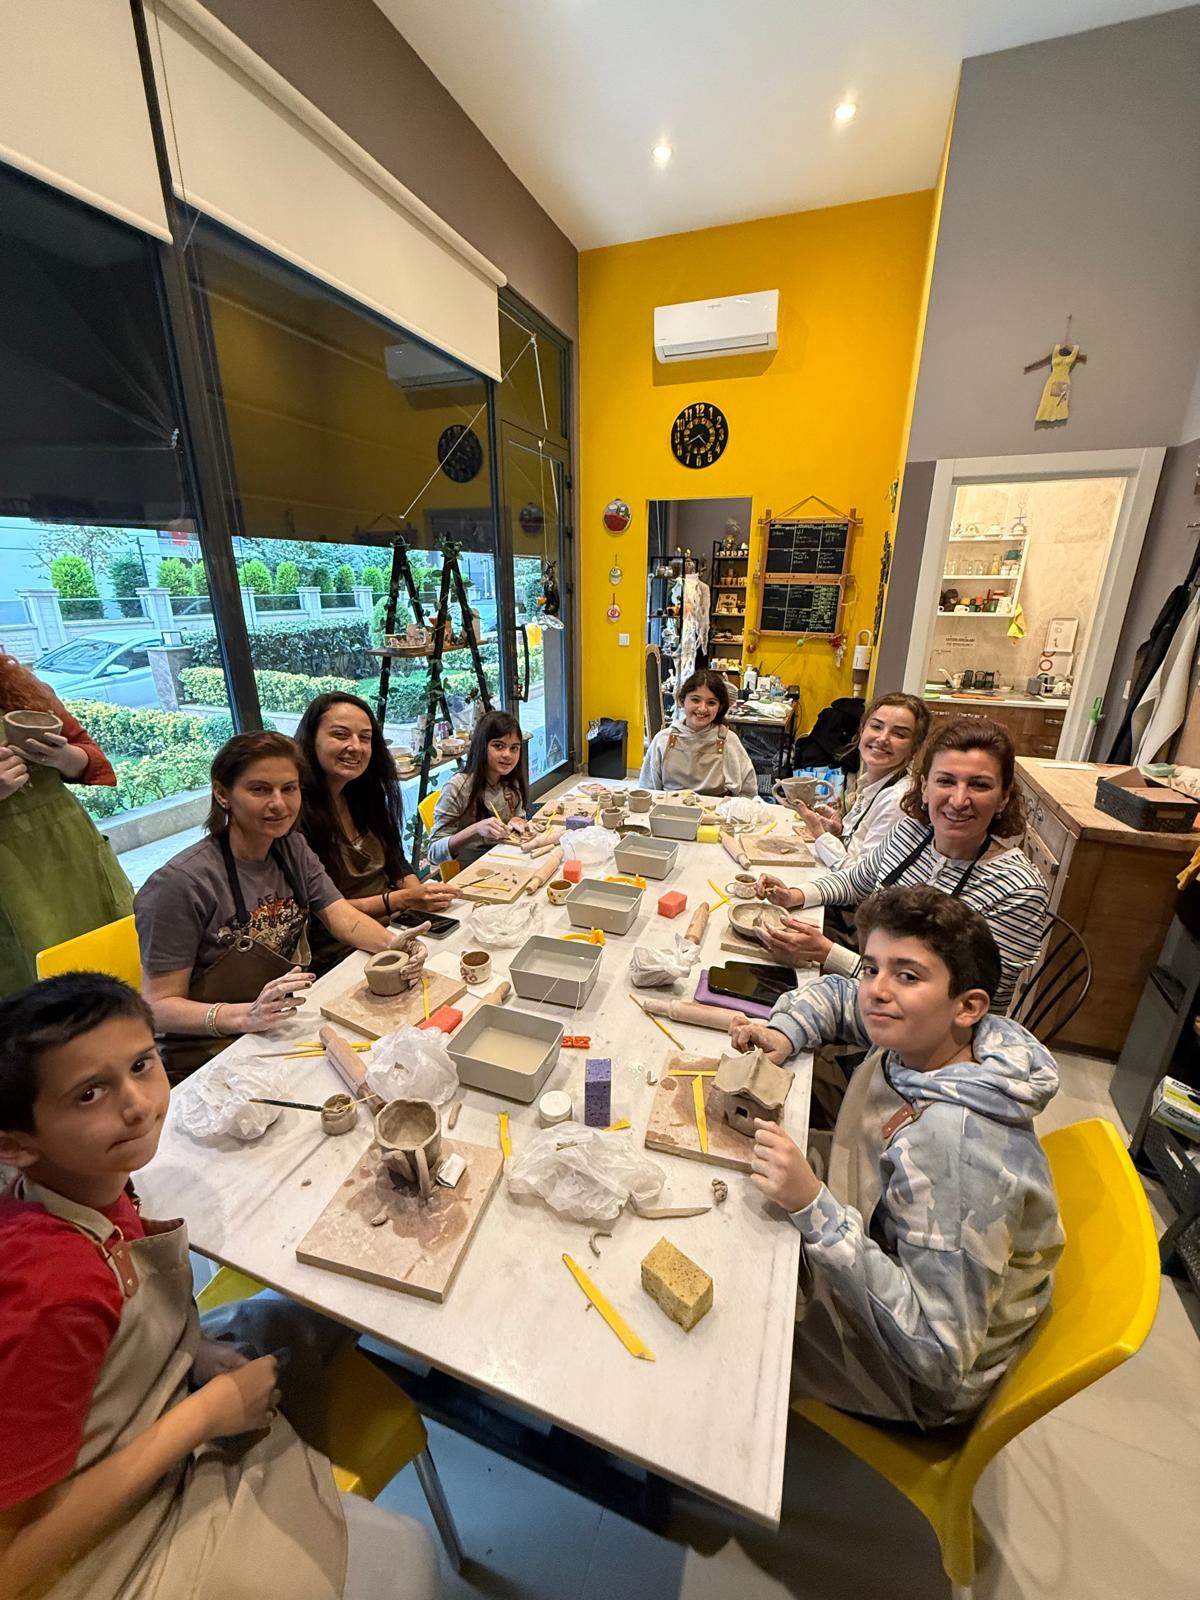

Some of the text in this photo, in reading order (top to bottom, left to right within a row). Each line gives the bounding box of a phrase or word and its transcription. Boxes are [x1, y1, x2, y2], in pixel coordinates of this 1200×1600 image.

[684, 409, 693, 421] 11
[695, 404, 705, 417] 12
[709, 407, 713, 419] 1
[716, 416, 722, 428] 2
[707, 451, 713, 463] 5
